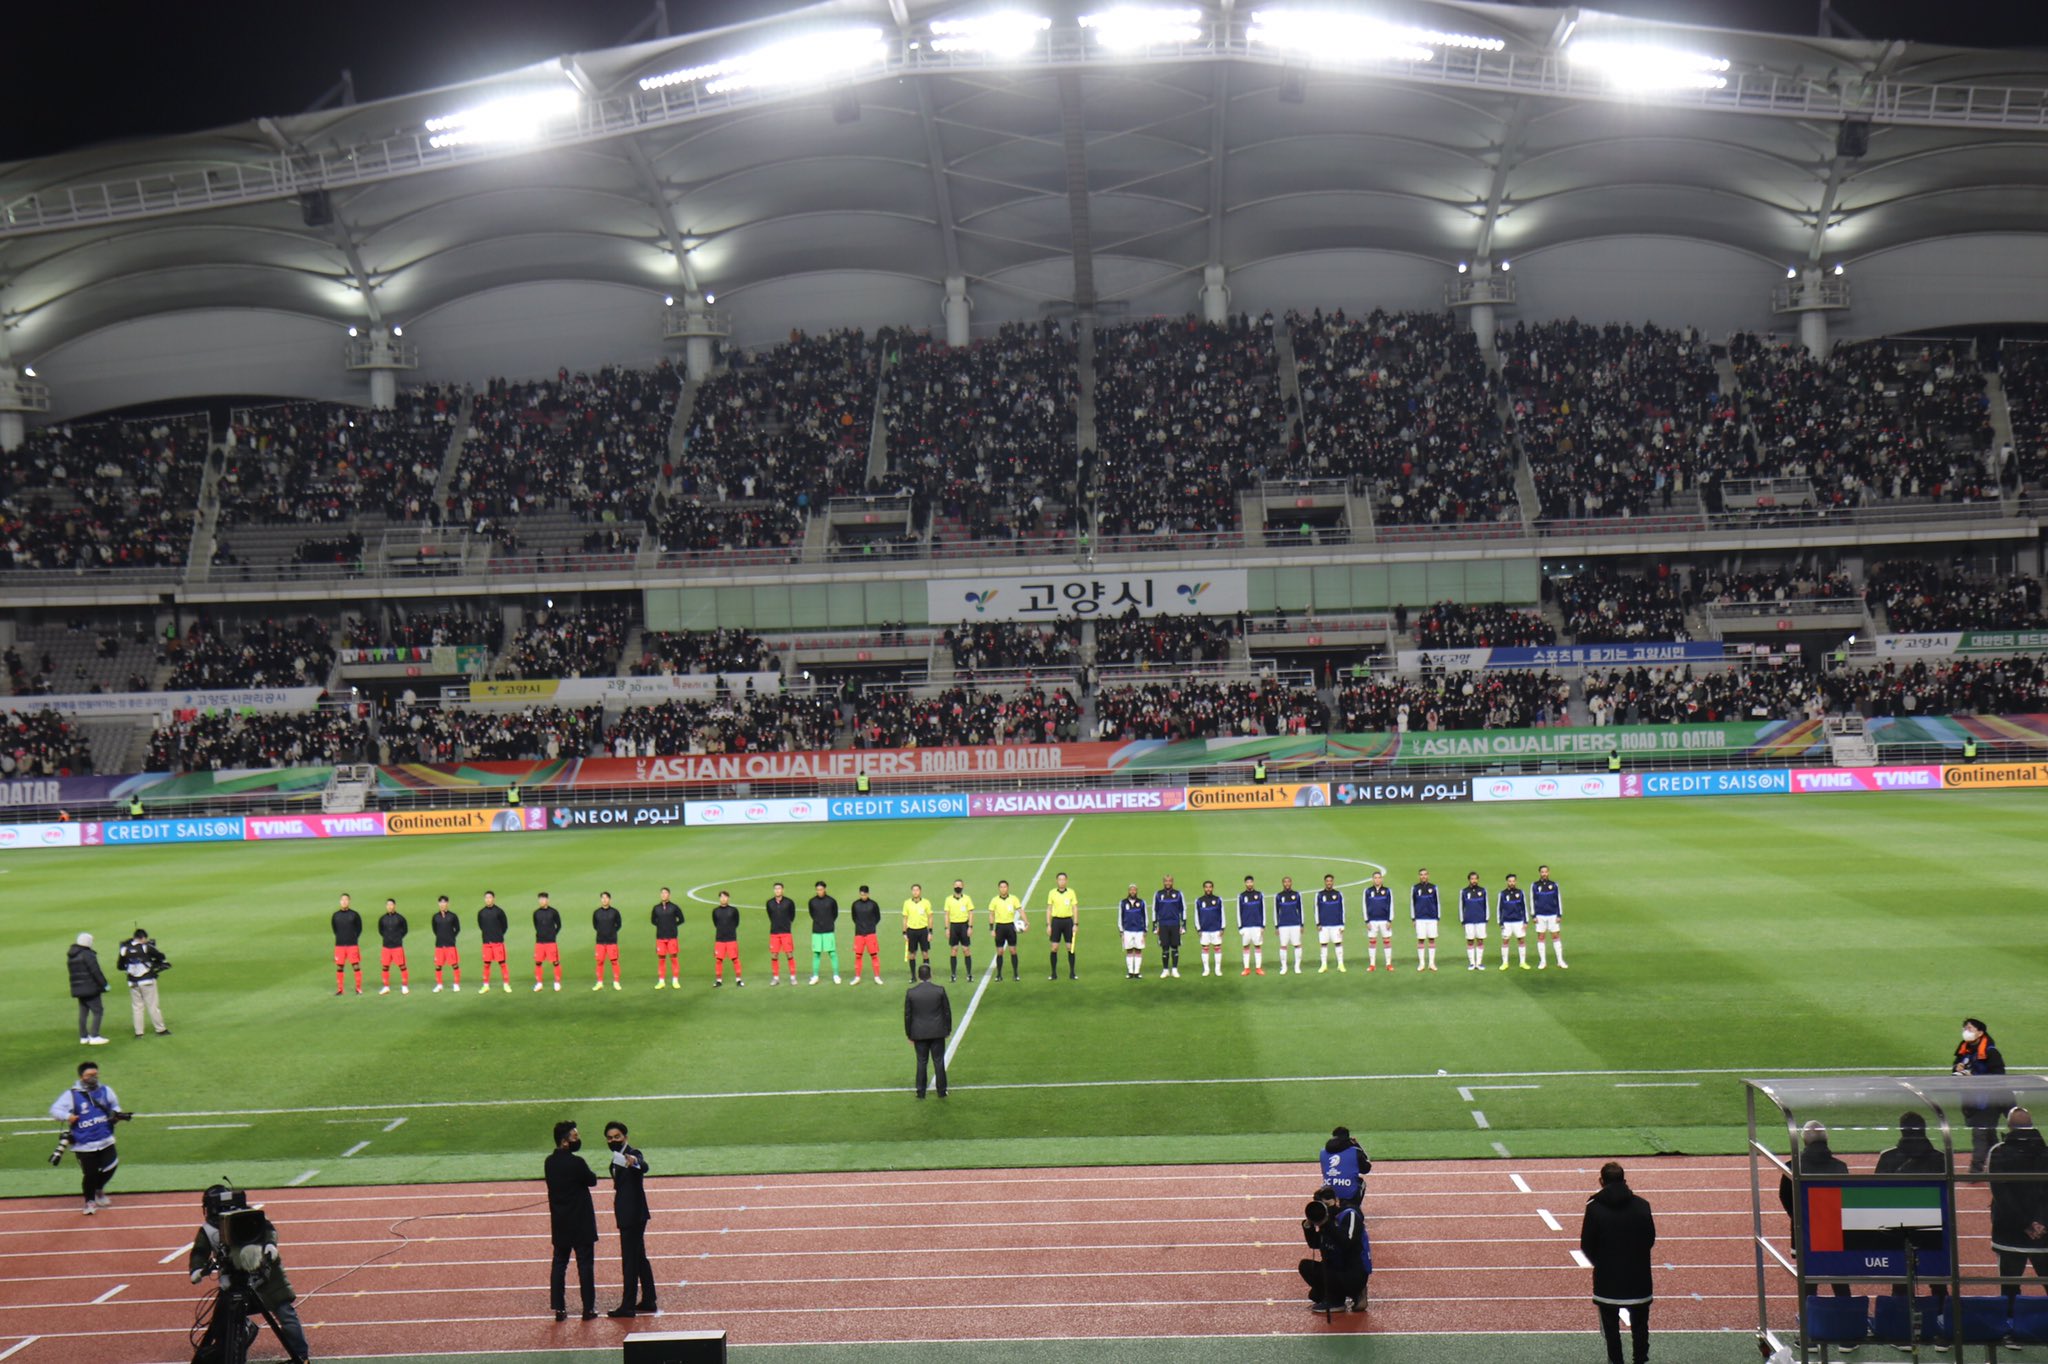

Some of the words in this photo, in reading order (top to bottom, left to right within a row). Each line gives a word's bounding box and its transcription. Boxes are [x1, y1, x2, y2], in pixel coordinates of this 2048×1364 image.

[1019, 579, 1153, 613] 고양시
[1904, 636, 1948, 648] 고양시
[1533, 650, 1583, 663] 스포츠를
[1633, 646, 1685, 660] 고양시민
[504, 684, 541, 695] 고양시
[1423, 736, 1489, 755] ASIAN
[1492, 733, 1616, 752] QUALIFIERS
[1621, 732, 1656, 749] ROAD
[1661, 732, 1677, 748] TO
[1682, 730, 1726, 748] QATAR
[636, 759, 646, 780] AFC
[650, 757, 740, 780] ASIAN
[746, 752, 916, 777] QUALIFIERS
[921, 751, 969, 772] ROAD
[975, 749, 997, 770] TO
[1004, 748, 1062, 771] QATAR
[1647, 776, 1711, 792] CREDIT
[1718, 773, 1785, 789] SAISON
[1797, 773, 1852, 787] TVING
[1873, 770, 1928, 785] TVING
[1945, 766, 2037, 786] Continental
[1188, 788, 1274, 808] Continental
[1359, 785, 1414, 800] NEOM
[1421, 781, 1467, 800] نيوم
[832, 799, 892, 816] CREDIT
[900, 797, 963, 814] SAISON
[994, 794, 1051, 812] ASIAN
[1054, 792, 1161, 810] QUALIFIERS
[387, 813, 472, 833] Continental
[573, 808, 628, 824] NEOM
[634, 805, 680, 824] نيوم
[108, 824, 169, 840] CREDIT
[176, 821, 240, 838] SAISON
[250, 820, 302, 835] TVING
[321, 817, 373, 832] TVING
[79, 1120, 94, 1128] LOC
[1323, 1178, 1331, 1186] OC
[1333, 1178, 1351, 1186] PHO
[1865, 1257, 1889, 1268] UAE
